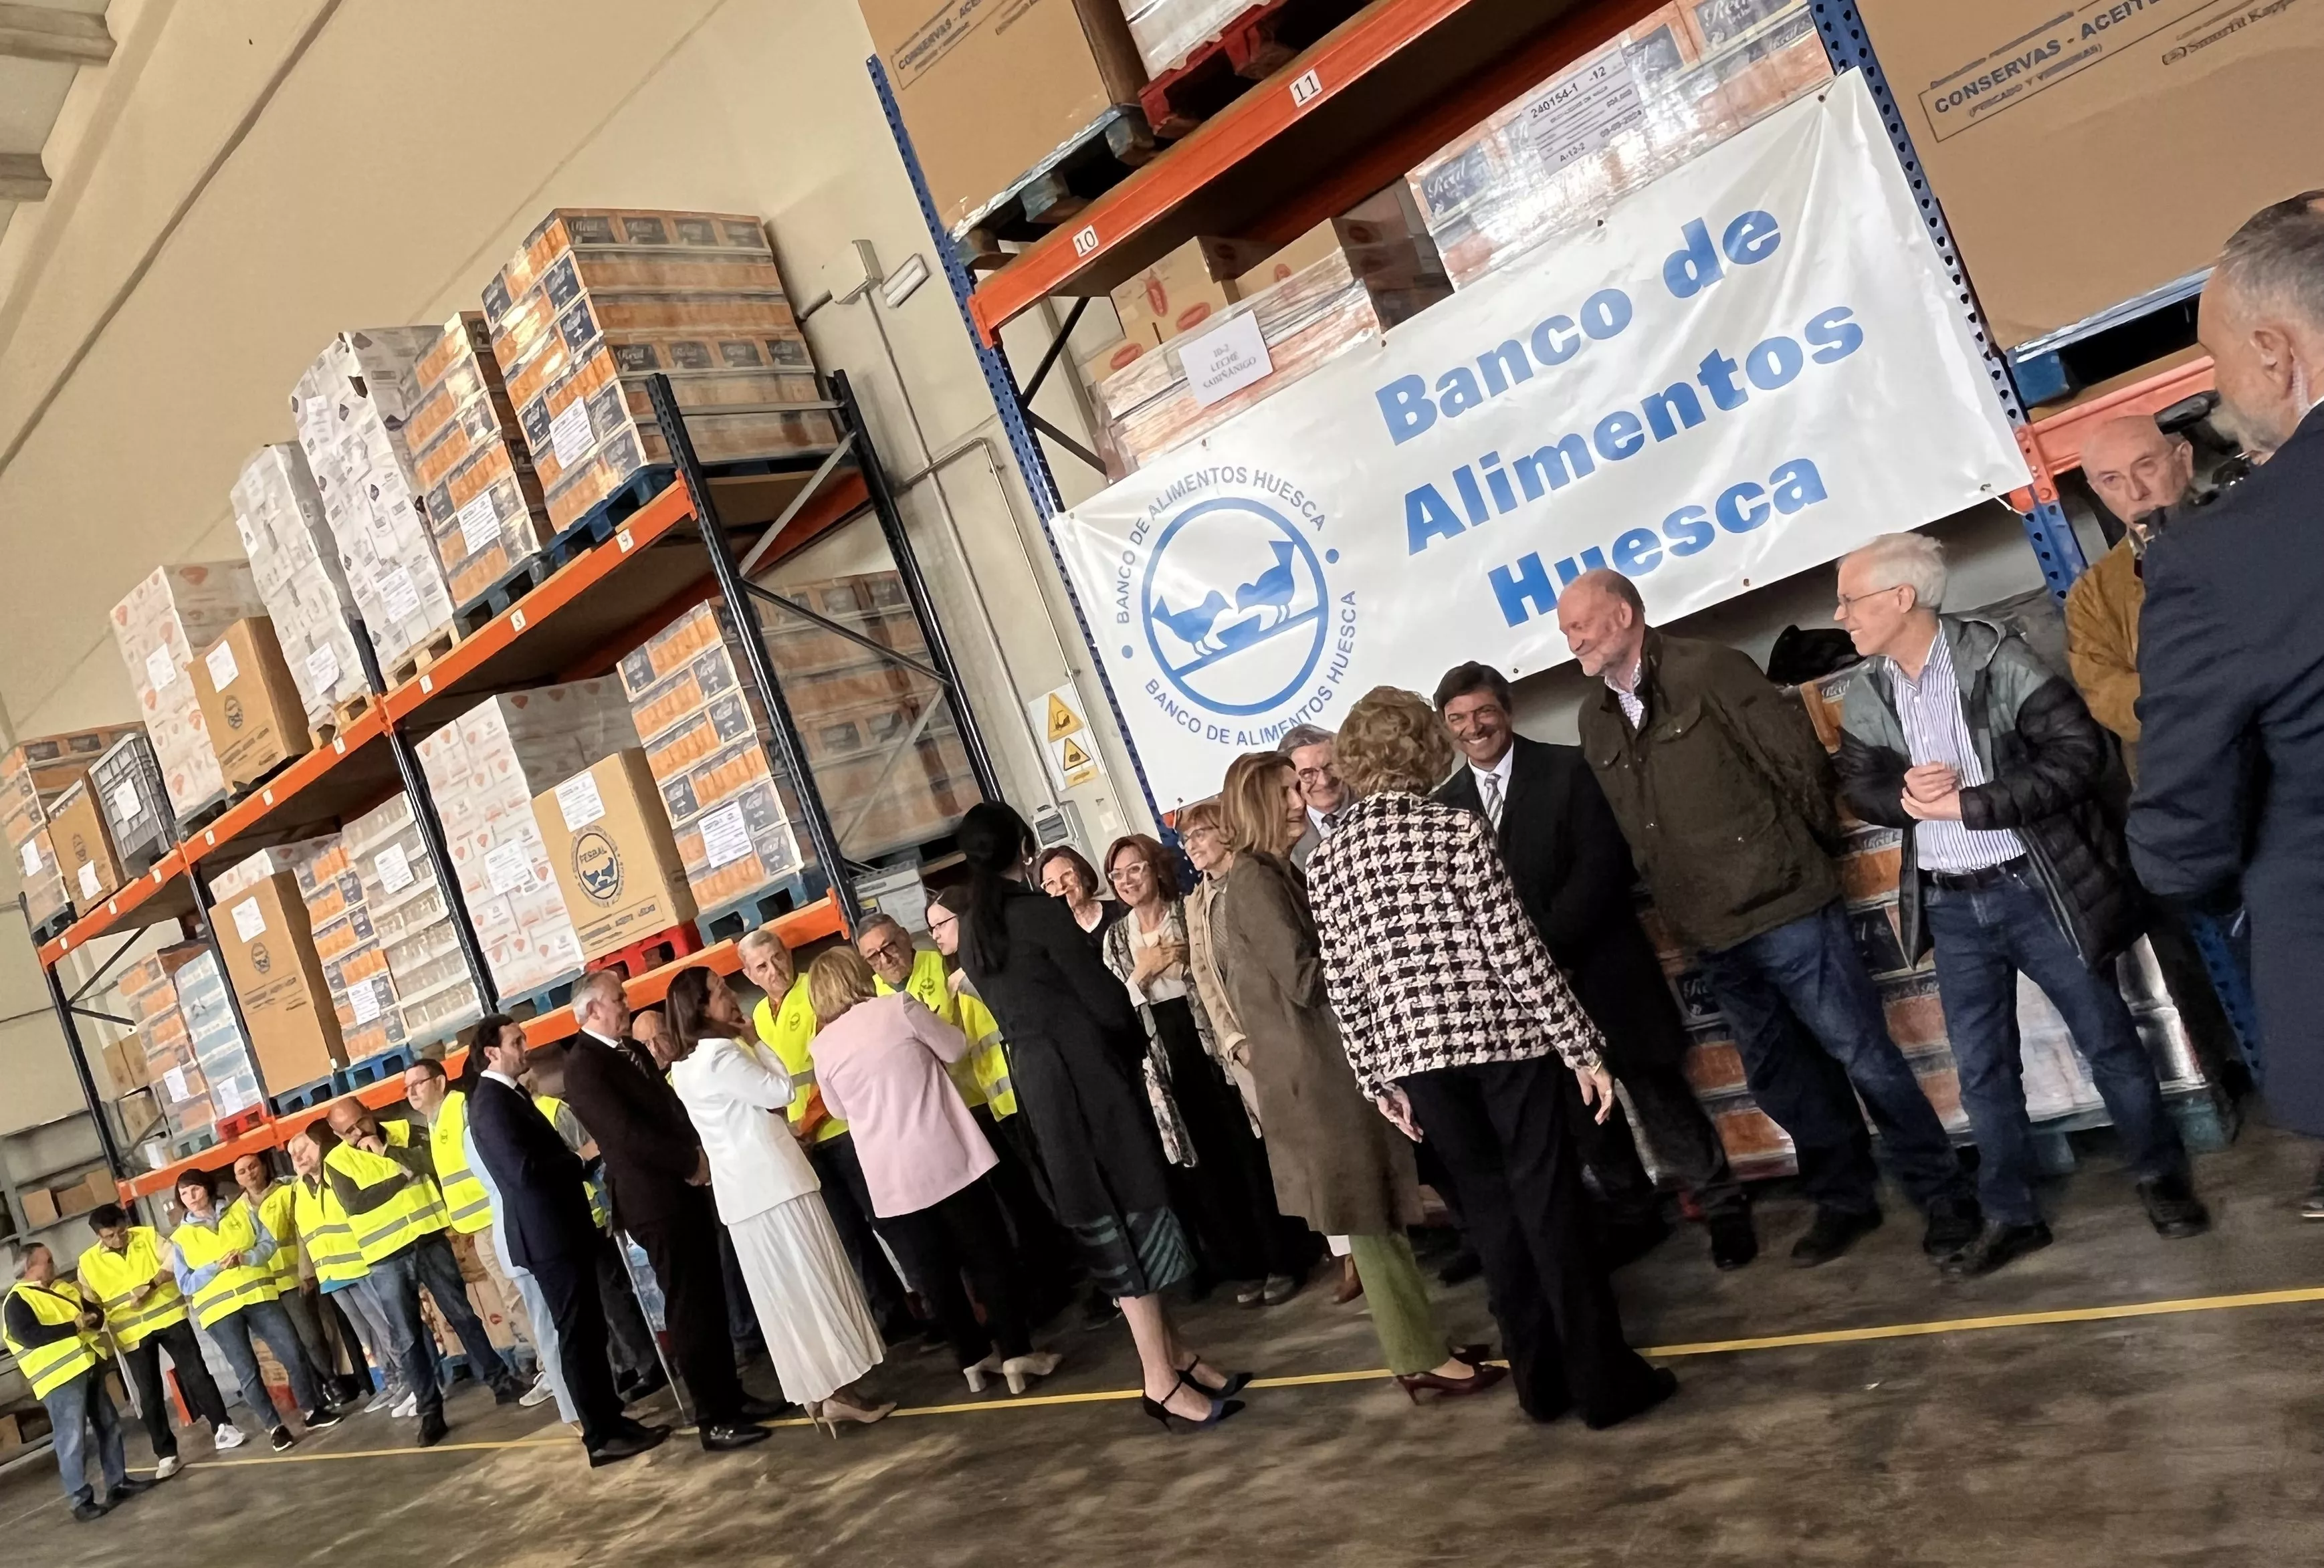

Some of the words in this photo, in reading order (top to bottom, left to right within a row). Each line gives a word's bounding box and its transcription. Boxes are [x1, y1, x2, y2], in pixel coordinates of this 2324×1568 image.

[899, 18, 952, 70] CONSERVAS
[1934, 39, 2061, 113] CONSERVAS
[2081, 0, 2161, 40] ACEIT
[1293, 75, 1319, 103] 11
[1531, 83, 1579, 119] 240154-1
[1075, 230, 1095, 255] 10
[1210, 350, 1240, 373] LECHE
[1375, 288, 1633, 446] Banco
[1663, 210, 1781, 299] de
[1405, 306, 1864, 556] Alimentos
[1116, 549, 1136, 625] BANCO
[1128, 517, 1151, 546] DE
[1148, 466, 1248, 522] ALIMENTOS
[1253, 469, 1327, 532] HUESCA
[1144, 678, 1202, 734] BANCO
[1206, 724, 1231, 744] DE
[1236, 685, 1333, 747] ALIMENTOS
[1326, 590, 1357, 685] HUESCA
